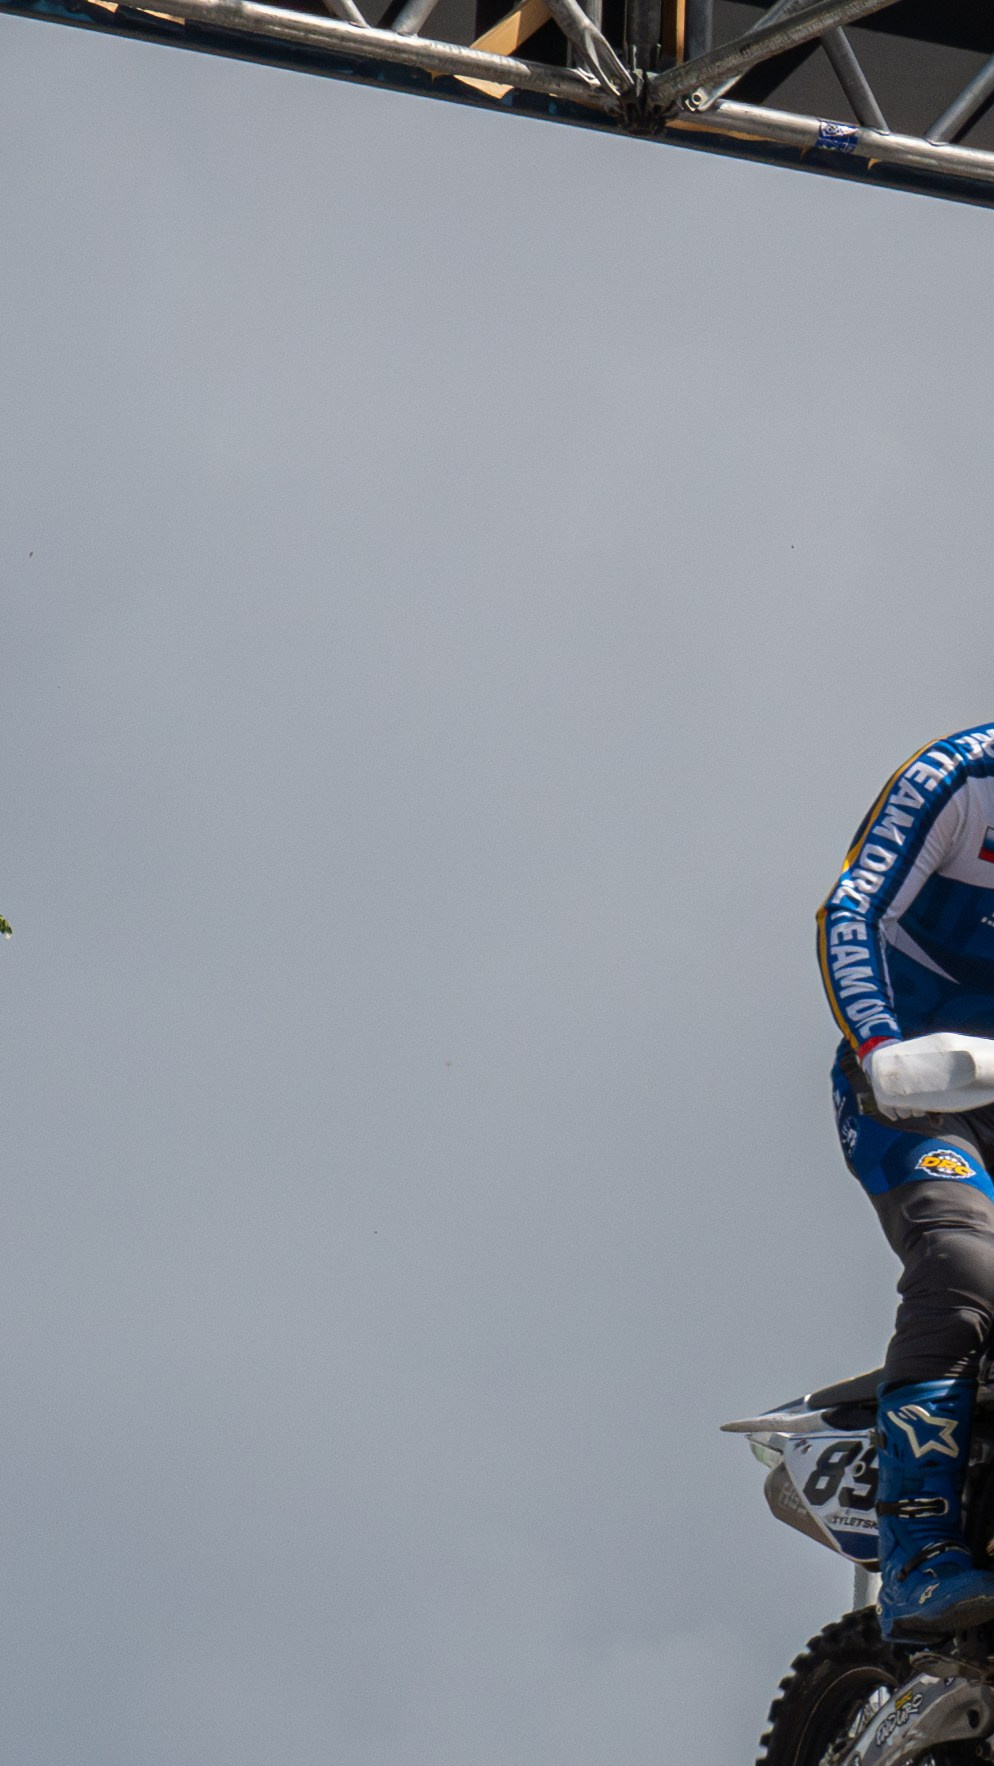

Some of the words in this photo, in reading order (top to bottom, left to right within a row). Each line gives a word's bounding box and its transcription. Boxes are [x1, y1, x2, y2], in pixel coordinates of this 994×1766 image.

[832, 843, 899, 914] DRC
[919, 1156, 972, 1177] DRC
[803, 1440, 879, 1511] 89
